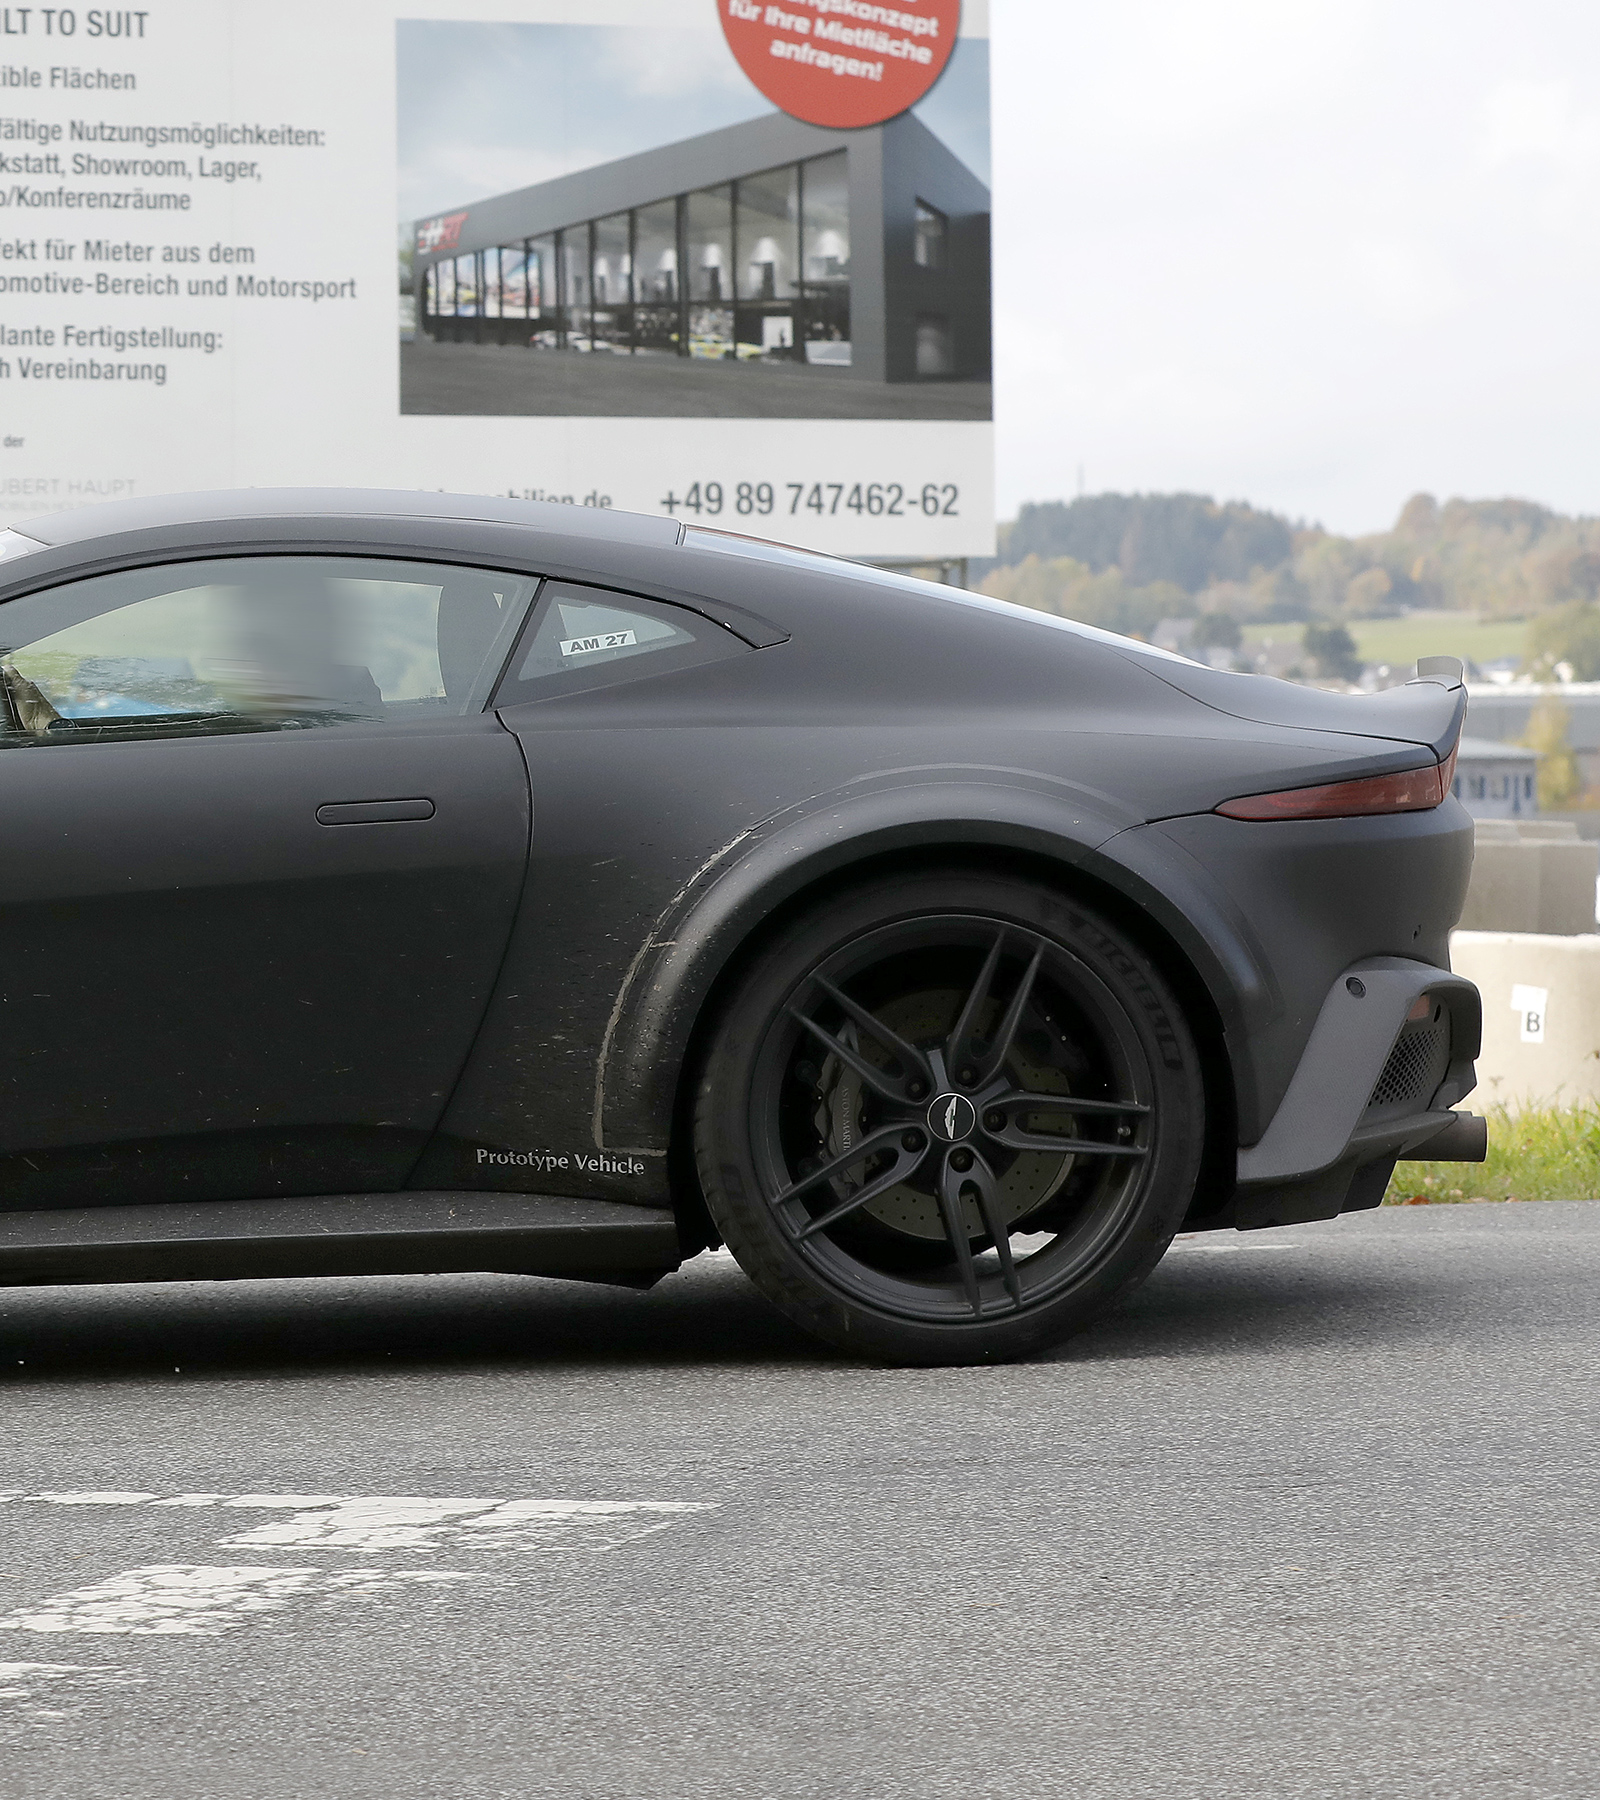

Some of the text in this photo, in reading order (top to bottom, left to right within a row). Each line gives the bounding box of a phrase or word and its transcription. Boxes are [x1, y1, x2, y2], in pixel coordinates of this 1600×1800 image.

[40, 8, 77, 37] TO
[86, 9, 150, 39] SUIT
[764, 5, 811, 35] Ihre
[814, 17, 934, 65] Mietfläche
[769, 40, 884, 81] anfragen!
[49, 66, 137, 91] Flächen
[69, 119, 326, 150] Nutzungsmöglichkeiten:
[71, 153, 193, 181] Showroom,
[198, 156, 262, 184] Lager,
[44, 237, 76, 262] für
[83, 239, 155, 263] Mieter
[161, 244, 201, 264] aus
[208, 241, 256, 265] dem
[186, 274, 229, 298] und
[236, 274, 357, 303] Motorsport
[63, 323, 224, 354] Fertigstellung:
[17, 358, 167, 385] Vereinbarung
[3, 433, 26, 449] der
[67, 478, 136, 497] HAUPT
[660, 481, 960, 517] +49 89 747462-62
[570, 633, 628, 653] AM 27
[1525, 1011, 1541, 1034] B
[841, 1119, 852, 1151] MARTI
[476, 1148, 645, 1176] Prototype Vehicle
